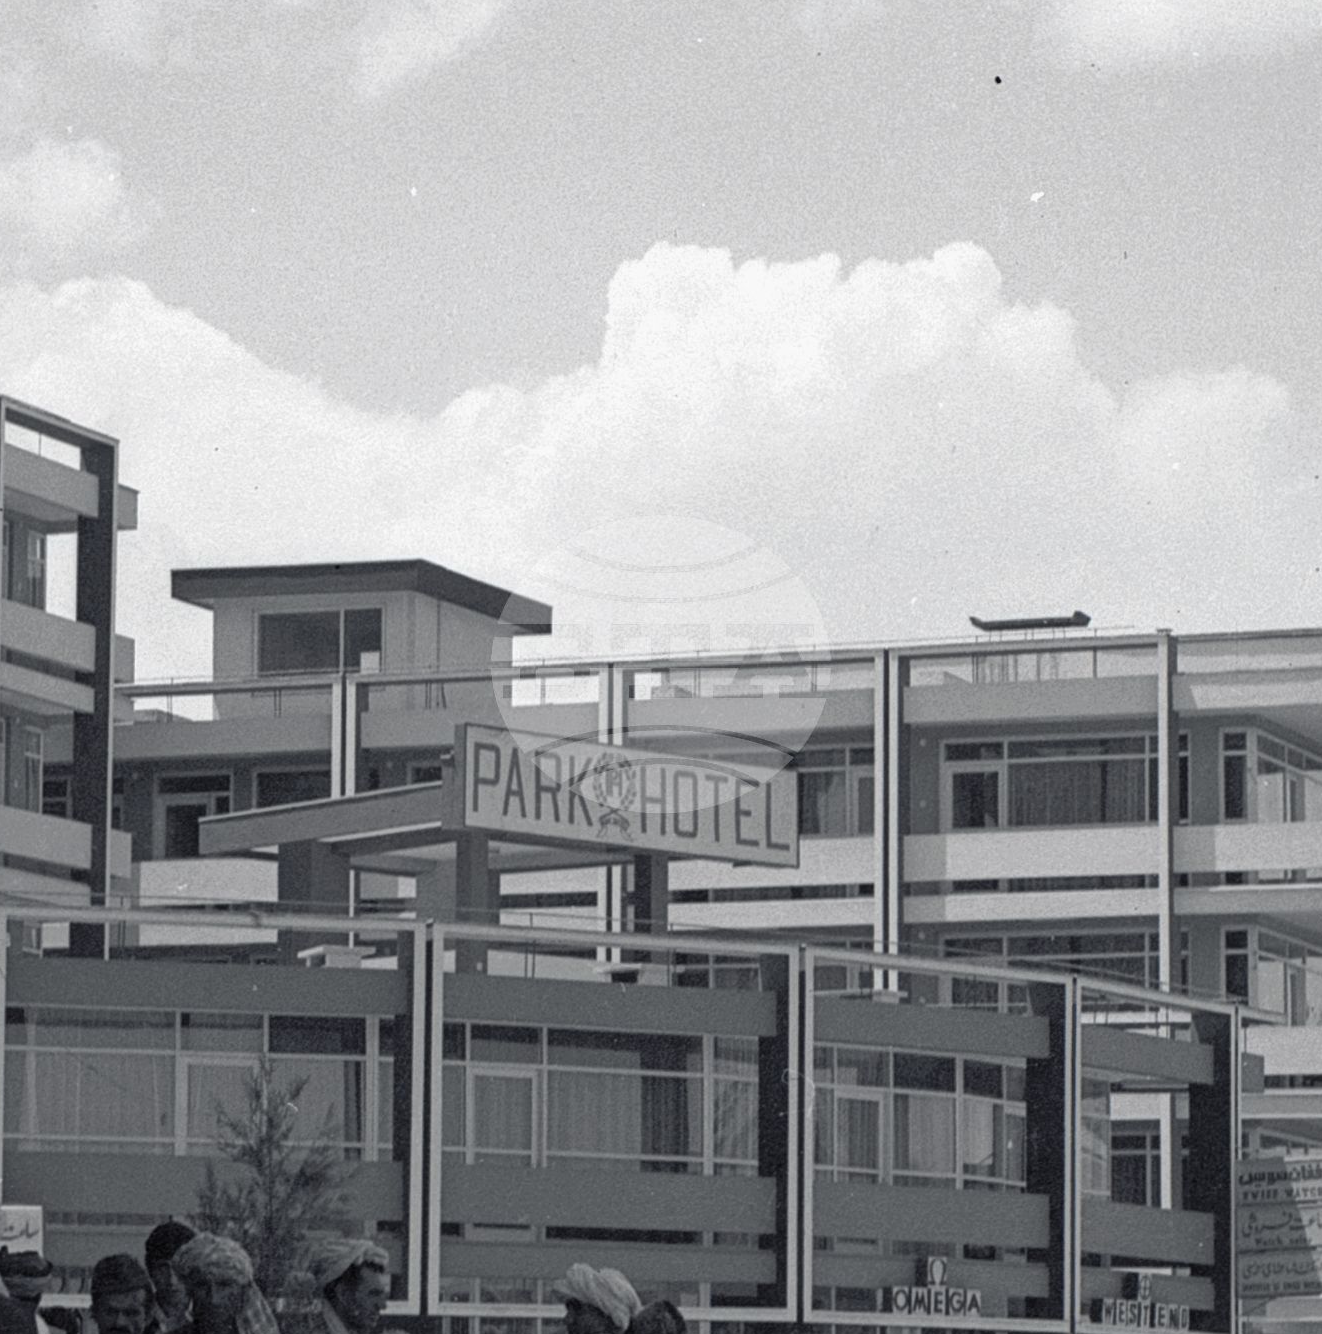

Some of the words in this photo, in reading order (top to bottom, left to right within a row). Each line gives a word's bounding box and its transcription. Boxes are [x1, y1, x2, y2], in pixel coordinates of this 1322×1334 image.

[472, 741, 593, 827] PARK
[640, 759, 791, 851] HOTEL
[893, 1287, 981, 1314] OMEGA
